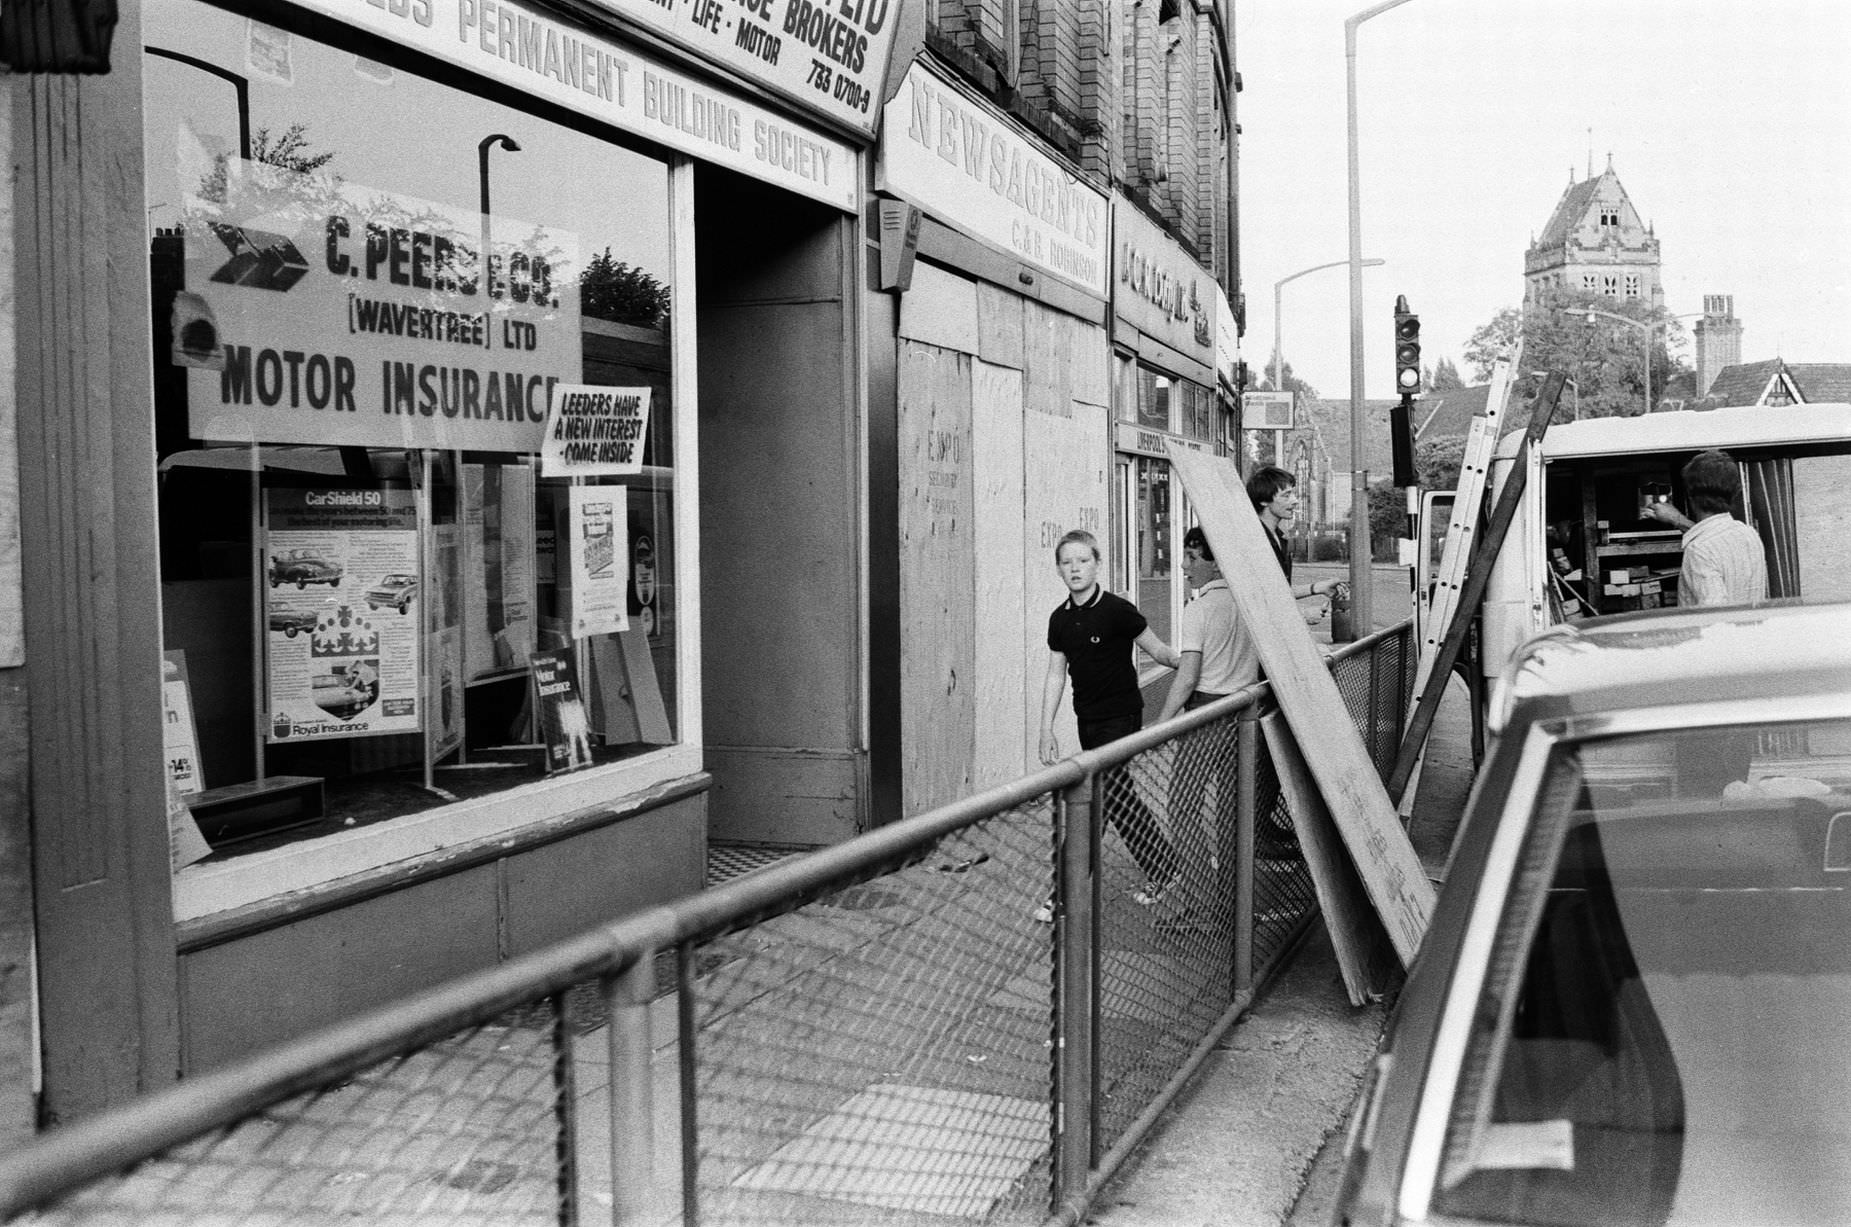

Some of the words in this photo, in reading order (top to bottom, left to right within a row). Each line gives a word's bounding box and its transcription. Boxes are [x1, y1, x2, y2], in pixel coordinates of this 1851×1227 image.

[691, 0, 723, 35] LIFE
[735, 17, 782, 66] MOTOR
[782, 0, 867, 74] BROKERS
[459, 0, 629, 108] PERMANENT
[643, 70, 742, 152] BUILDING
[754, 118, 831, 186] SOCIETY
[806, 58, 833, 93] 733
[833, 73, 871, 114] 0700-9
[908, 71, 1098, 249] NEWSAGENTS
[502, 318, 537, 351] LTD
[221, 344, 357, 412] MOTOR
[561, 392, 612, 416] LEEDERS
[613, 394, 641, 417] HAVE
[554, 416, 563, 440] A
[564, 416, 592, 440] NEW
[593, 417, 643, 441] INTEREST
[598, 441, 634, 464] INSIDE
[305, 491, 363, 505] CarShield
[364, 492, 381, 505] 50
[293, 722, 321, 737] Royal
[321, 721, 369, 734] Insurance
